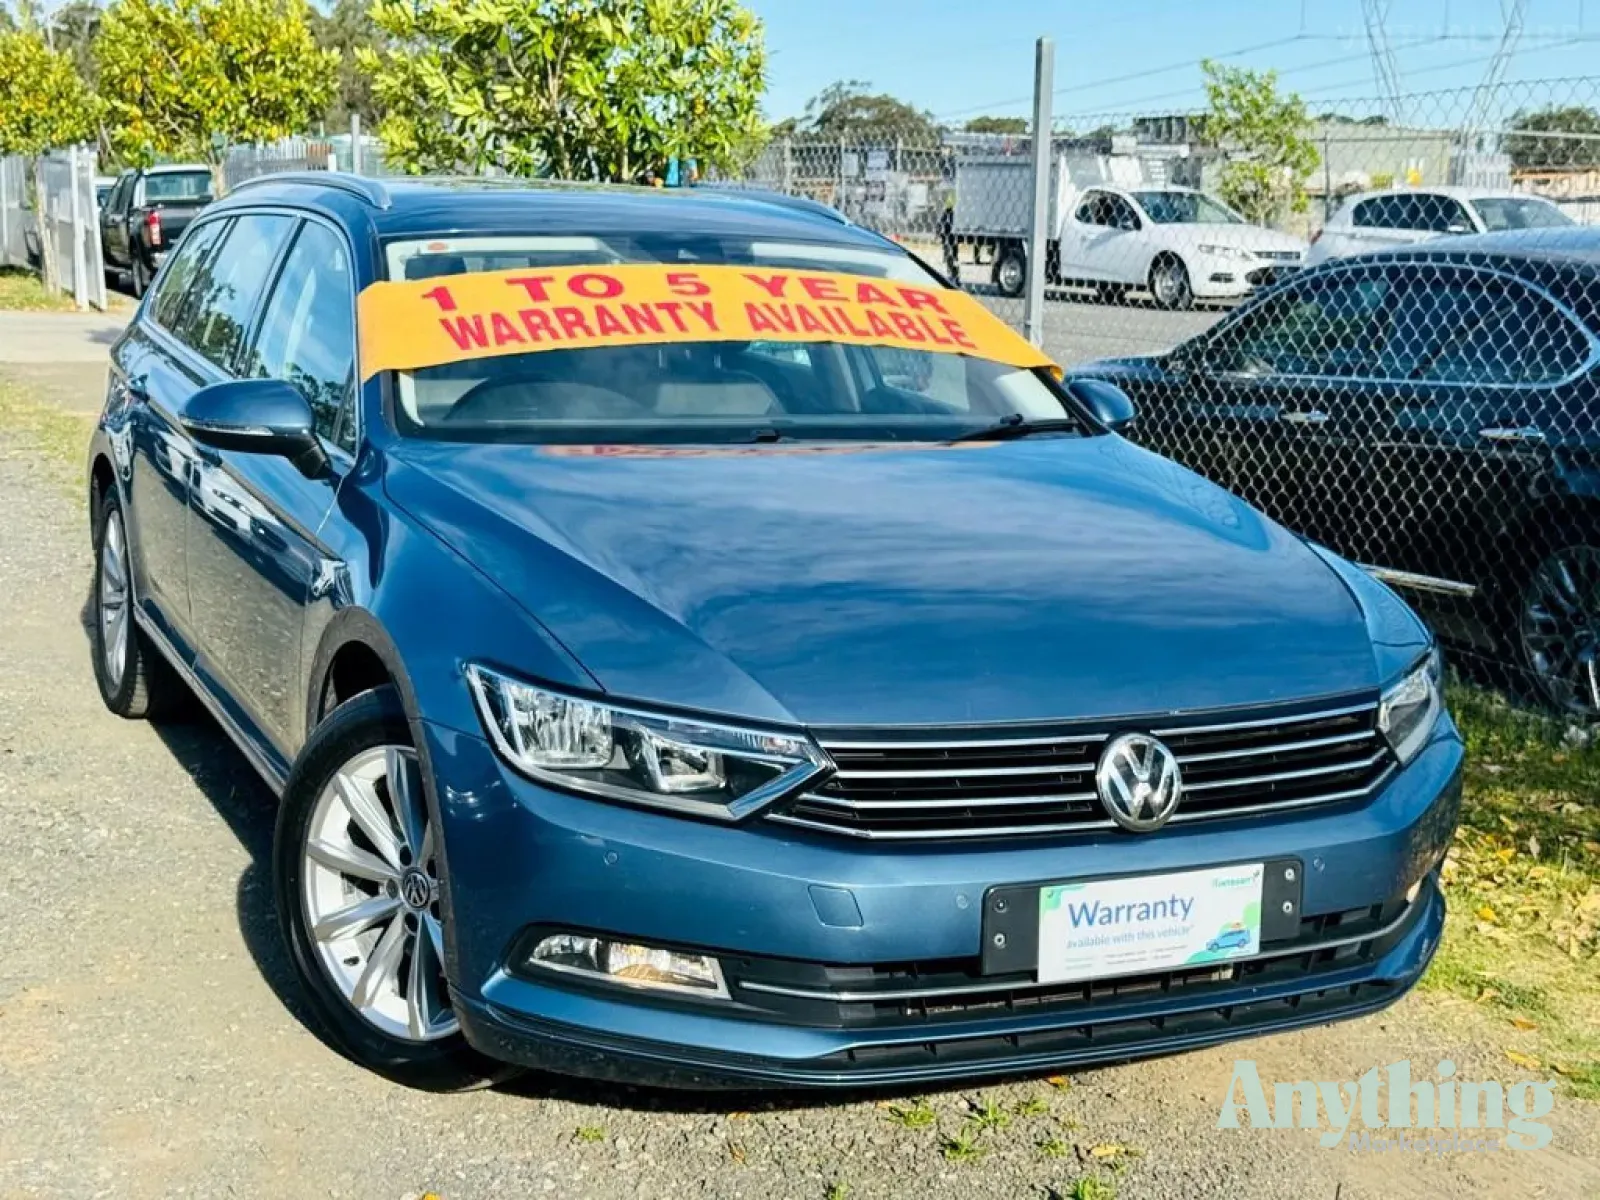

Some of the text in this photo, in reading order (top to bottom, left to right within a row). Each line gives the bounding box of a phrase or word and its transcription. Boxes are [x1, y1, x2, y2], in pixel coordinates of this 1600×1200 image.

[421, 272, 951, 315] 1 TO 5 YEAR
[438, 301, 978, 351] WARRANTY AVAILABLE
[1068, 893, 1195, 928] Warranty
